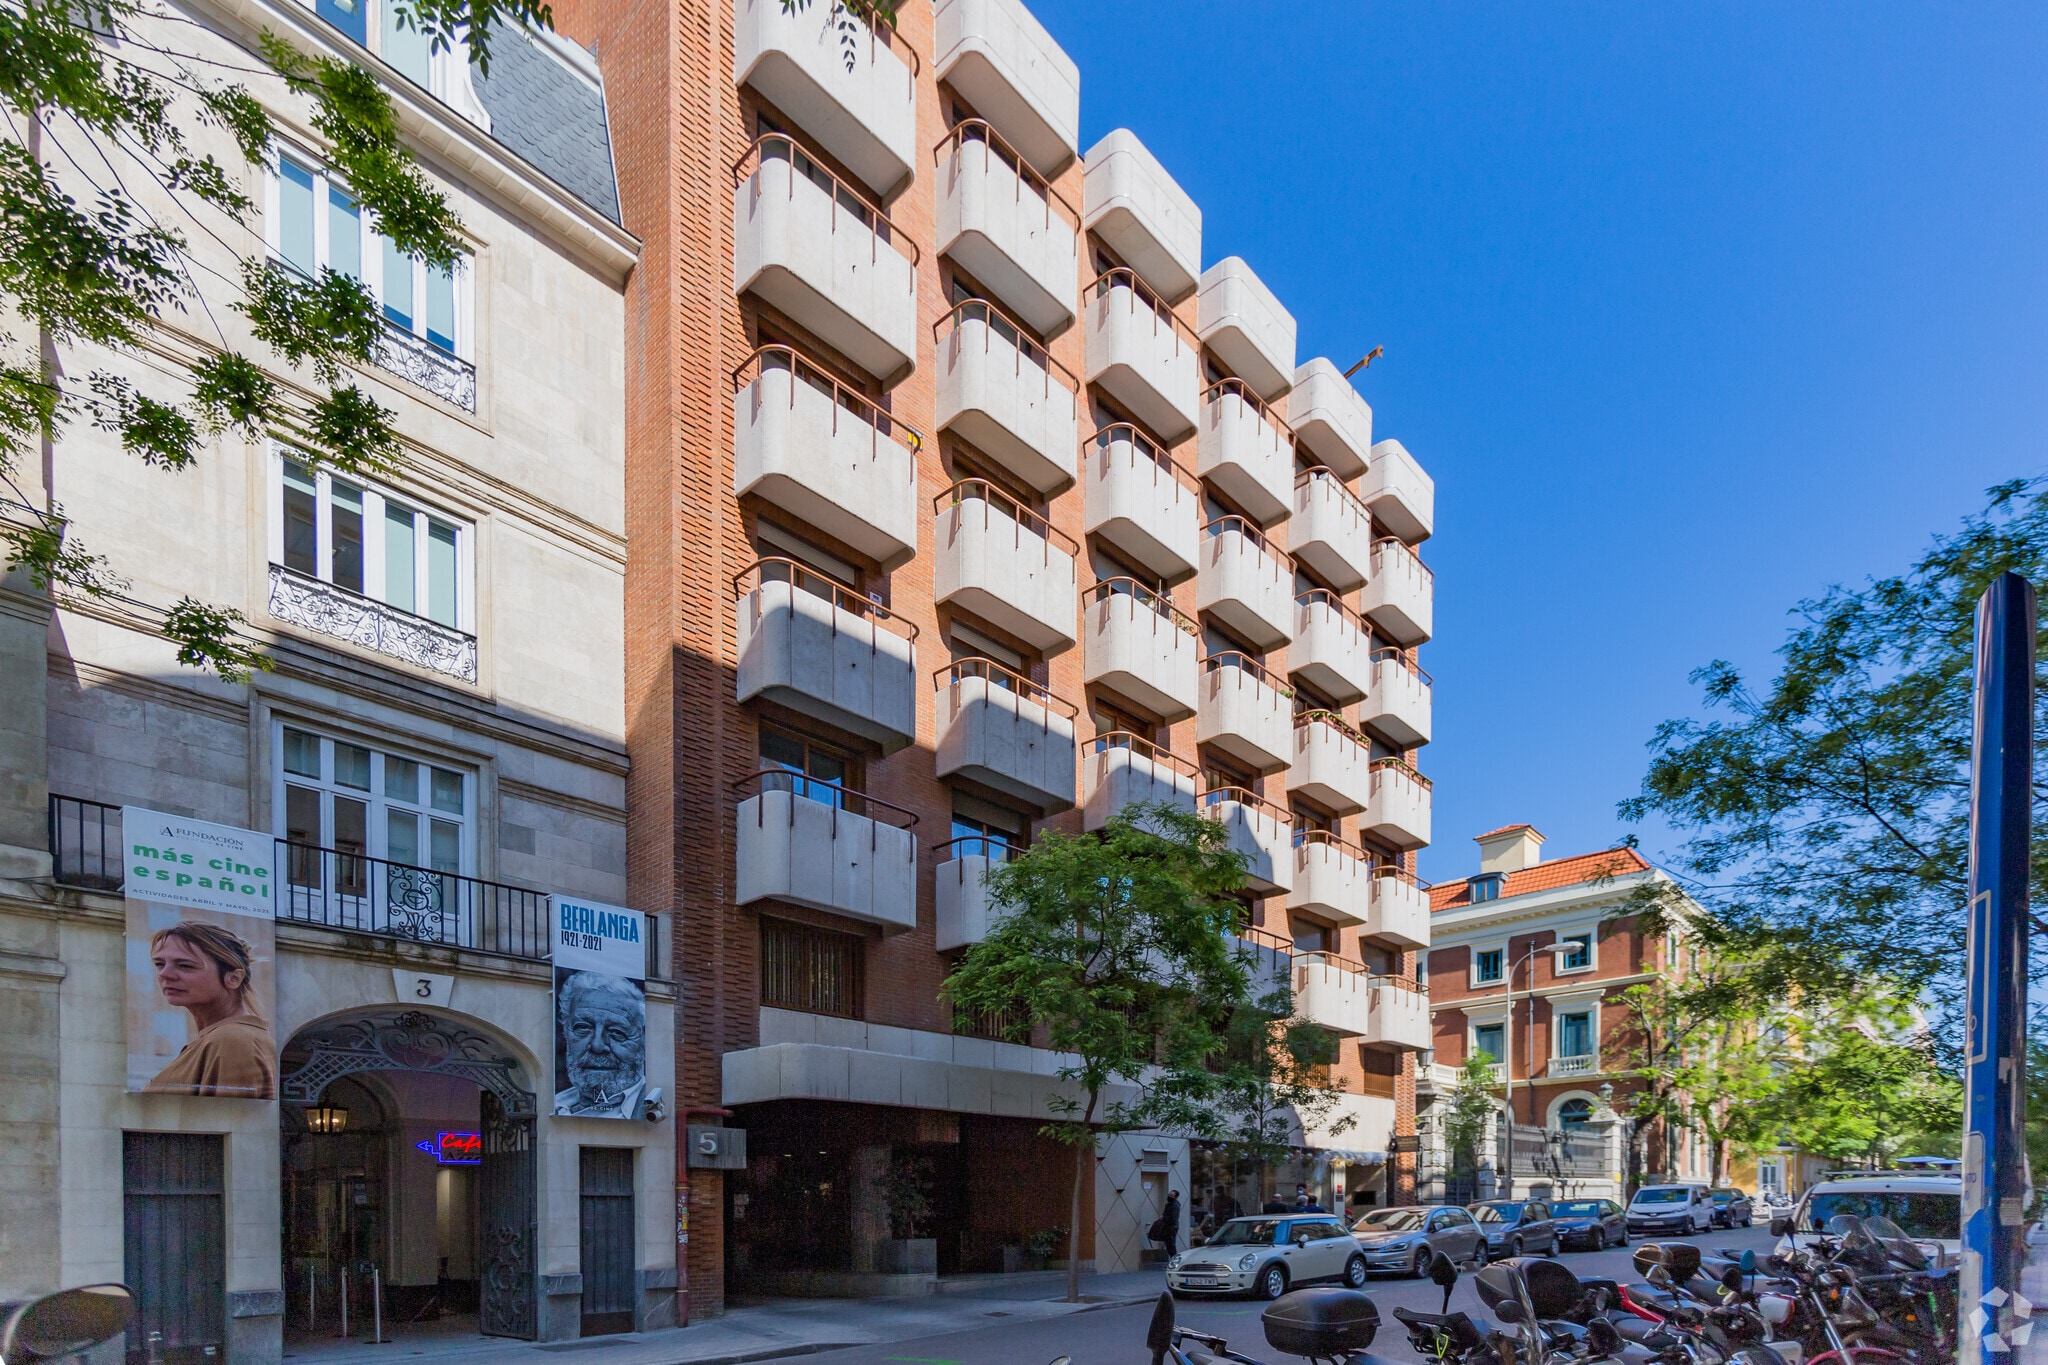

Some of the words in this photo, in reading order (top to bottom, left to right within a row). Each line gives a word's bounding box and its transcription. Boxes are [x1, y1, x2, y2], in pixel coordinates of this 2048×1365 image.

[176, 828, 244, 846] FUNDACIÓN
[133, 844, 194, 865] más
[208, 857, 269, 878] cine
[133, 865, 269, 898] español
[132, 888, 190, 901] ACTIVIDADES
[192, 897, 216, 906] ABRIL
[560, 903, 639, 943] BERLANGA
[561, 930, 602, 951] 1921-2021
[416, 978, 432, 997] 3
[699, 1132, 717, 1154] 5
